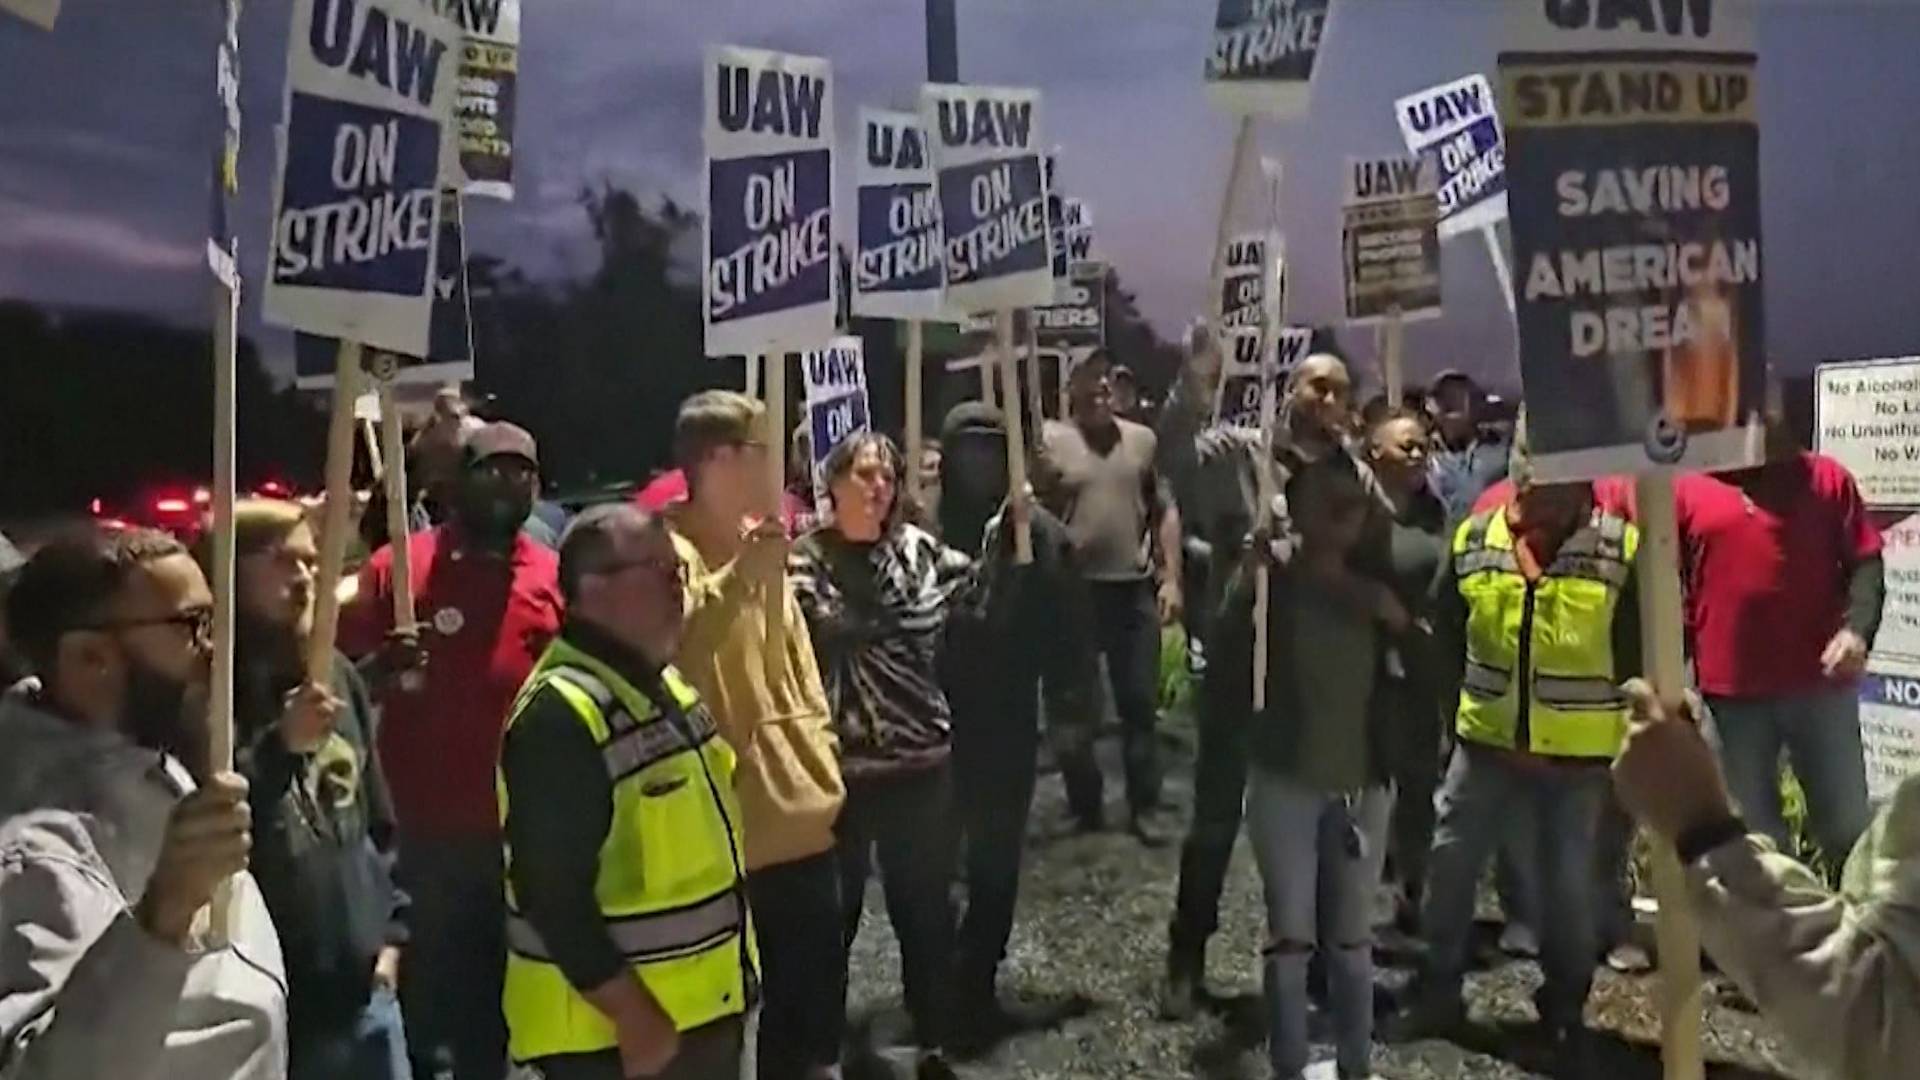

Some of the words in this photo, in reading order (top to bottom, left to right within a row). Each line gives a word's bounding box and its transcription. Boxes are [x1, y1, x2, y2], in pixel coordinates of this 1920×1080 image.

[1207, 10, 1325, 73] STRIKE
[718, 63, 824, 138] UAW
[1408, 83, 1482, 132] UAW
[1515, 73, 1682, 119] STAND
[1697, 73, 1748, 114] UP
[867, 121, 930, 169] UA
[937, 97, 1031, 148] UAW
[332, 120, 398, 190] ON
[1441, 131, 1477, 174] ON
[744, 160, 795, 231] ON
[970, 163, 1012, 219] ON
[1356, 159, 1422, 197] UAW
[1438, 148, 1506, 220] STRIKE
[1556, 164, 1731, 216] SAVING
[277, 188, 437, 277] STRIKE
[948, 198, 1044, 279] STRIKE
[1228, 240, 1265, 267] UA
[710, 207, 830, 317] STRIKE
[1524, 238, 1758, 300] AMERICAN
[809, 347, 859, 386] UAW
[1236, 335, 1304, 364] UW
[1828, 380, 1851, 395] No
[1874, 401, 1898, 415] No
[827, 397, 853, 443] ON
[1825, 424, 1846, 439] No
[1874, 446, 1898, 461] No
